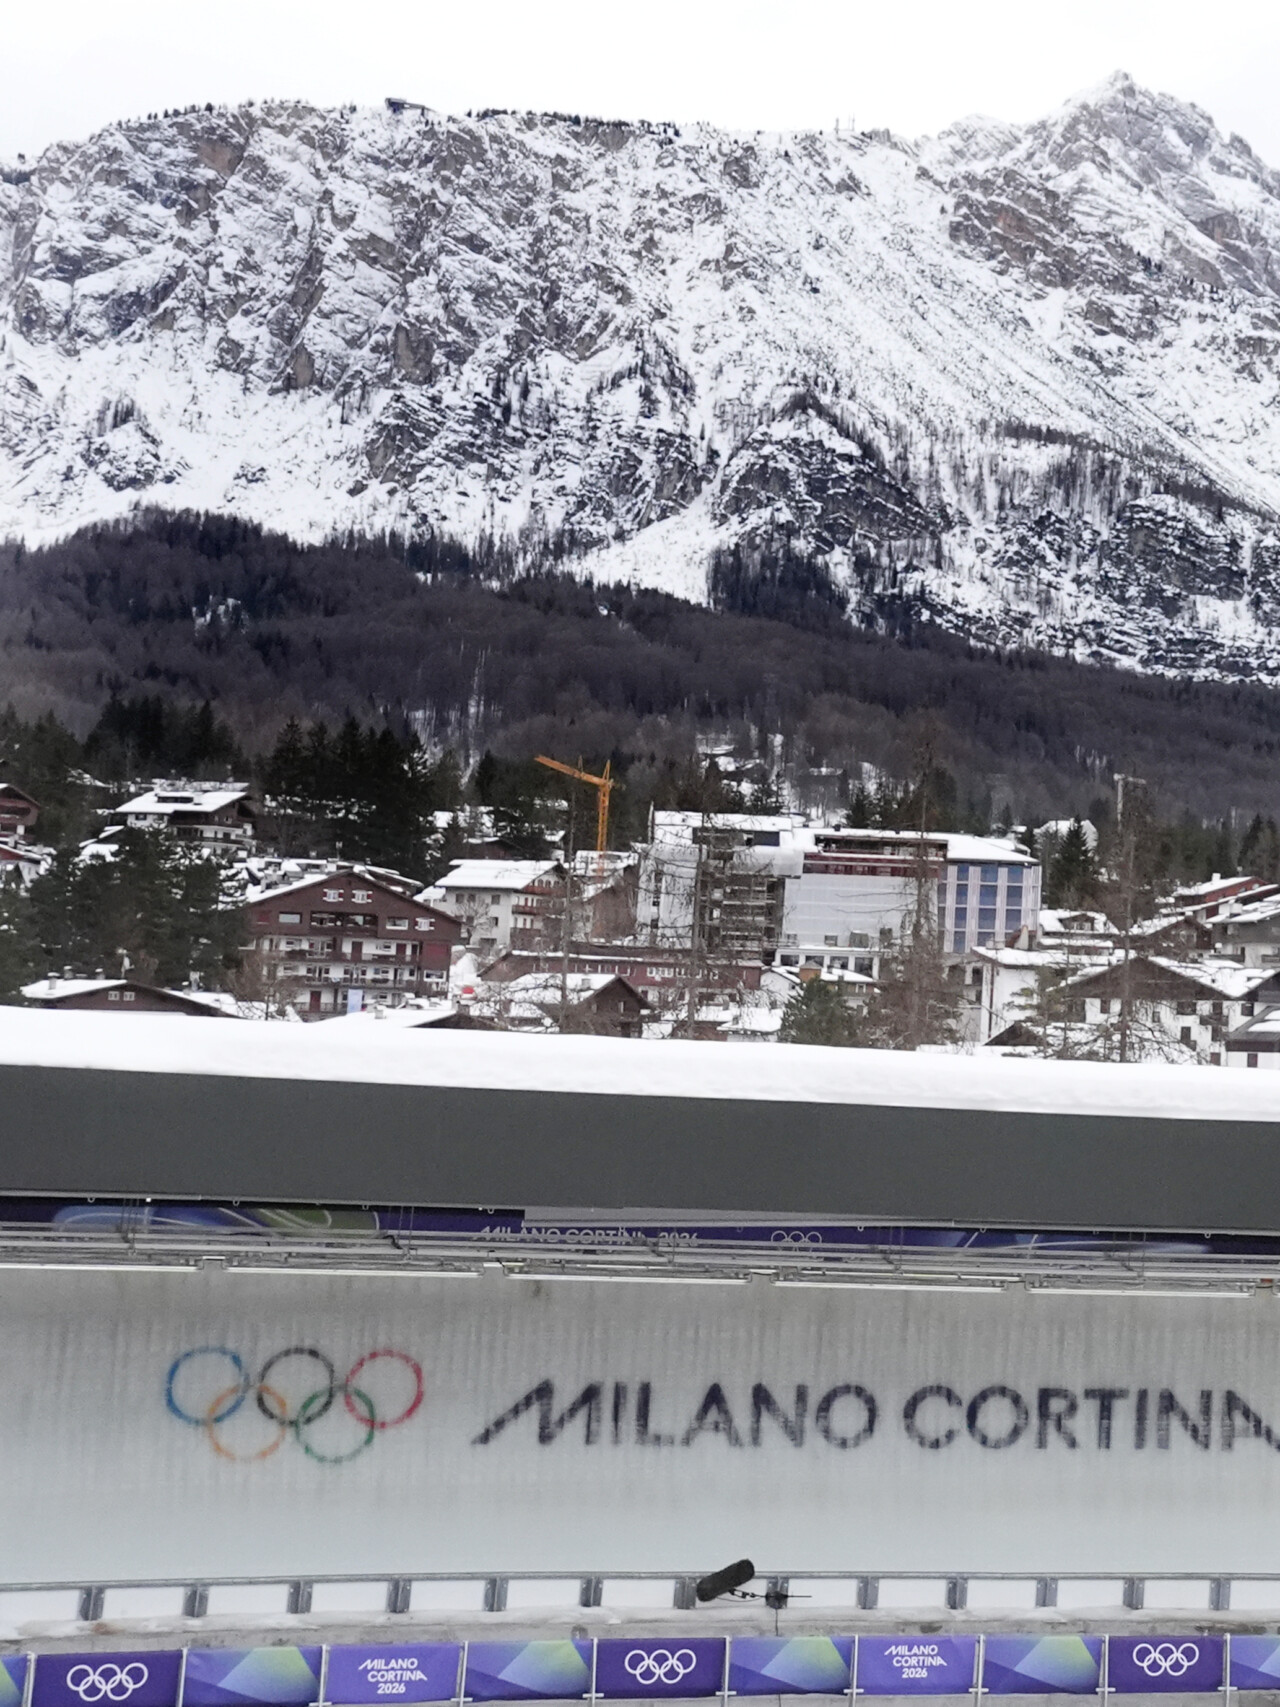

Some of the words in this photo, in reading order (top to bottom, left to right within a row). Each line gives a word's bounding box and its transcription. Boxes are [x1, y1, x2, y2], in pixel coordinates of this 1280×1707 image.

[470, 1378, 880, 1450] MILANO
[884, 1644, 938, 1656] MILANO
[358, 1657, 418, 1670] MILANO
[892, 1655, 948, 1667] CORTINA
[367, 1670, 428, 1682] CORTINA
[901, 1667, 928, 1679] 2026
[376, 1682, 406, 1695] 2026
